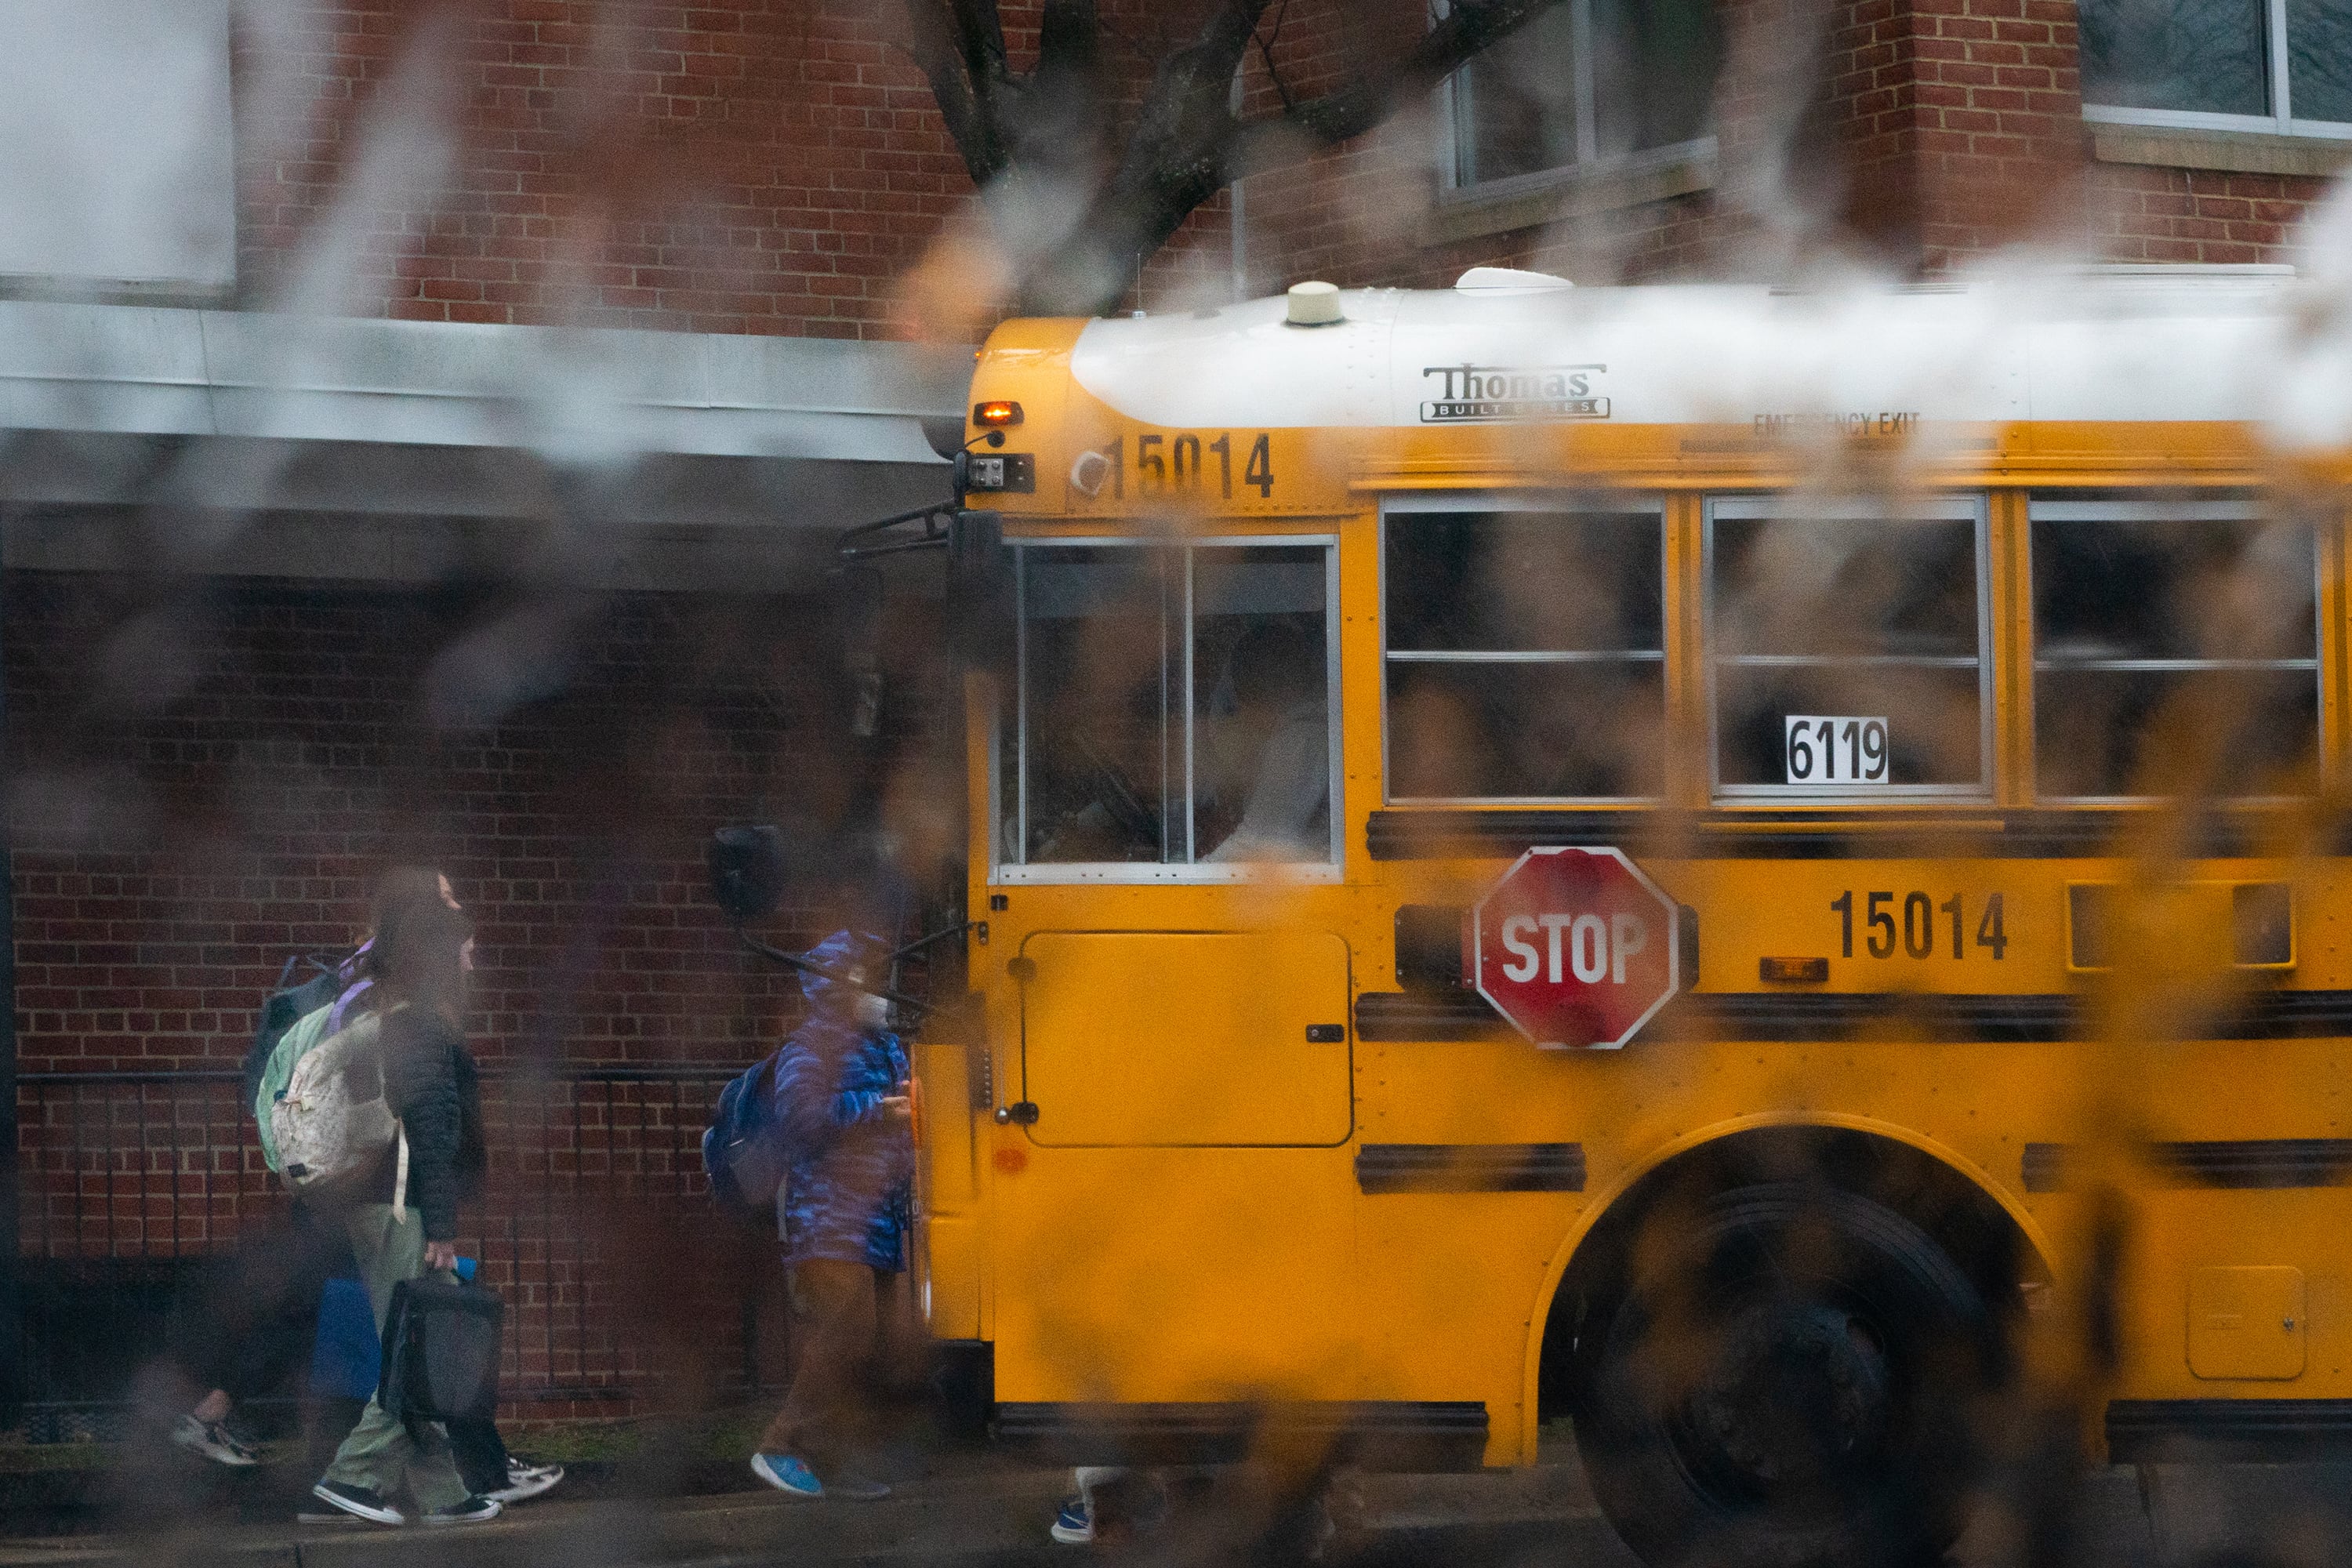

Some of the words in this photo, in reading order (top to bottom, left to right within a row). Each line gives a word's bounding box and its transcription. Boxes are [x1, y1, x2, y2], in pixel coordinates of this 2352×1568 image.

[1422, 362, 1607, 400] Thomas
[1439, 403, 1502, 416] BUILT
[1878, 411, 1920, 435] EXIT
[1102, 433, 1275, 499] 15014
[1788, 720, 1887, 780] 6119
[1501, 913, 1647, 984] STOP
[1831, 890, 2008, 960] 15014
